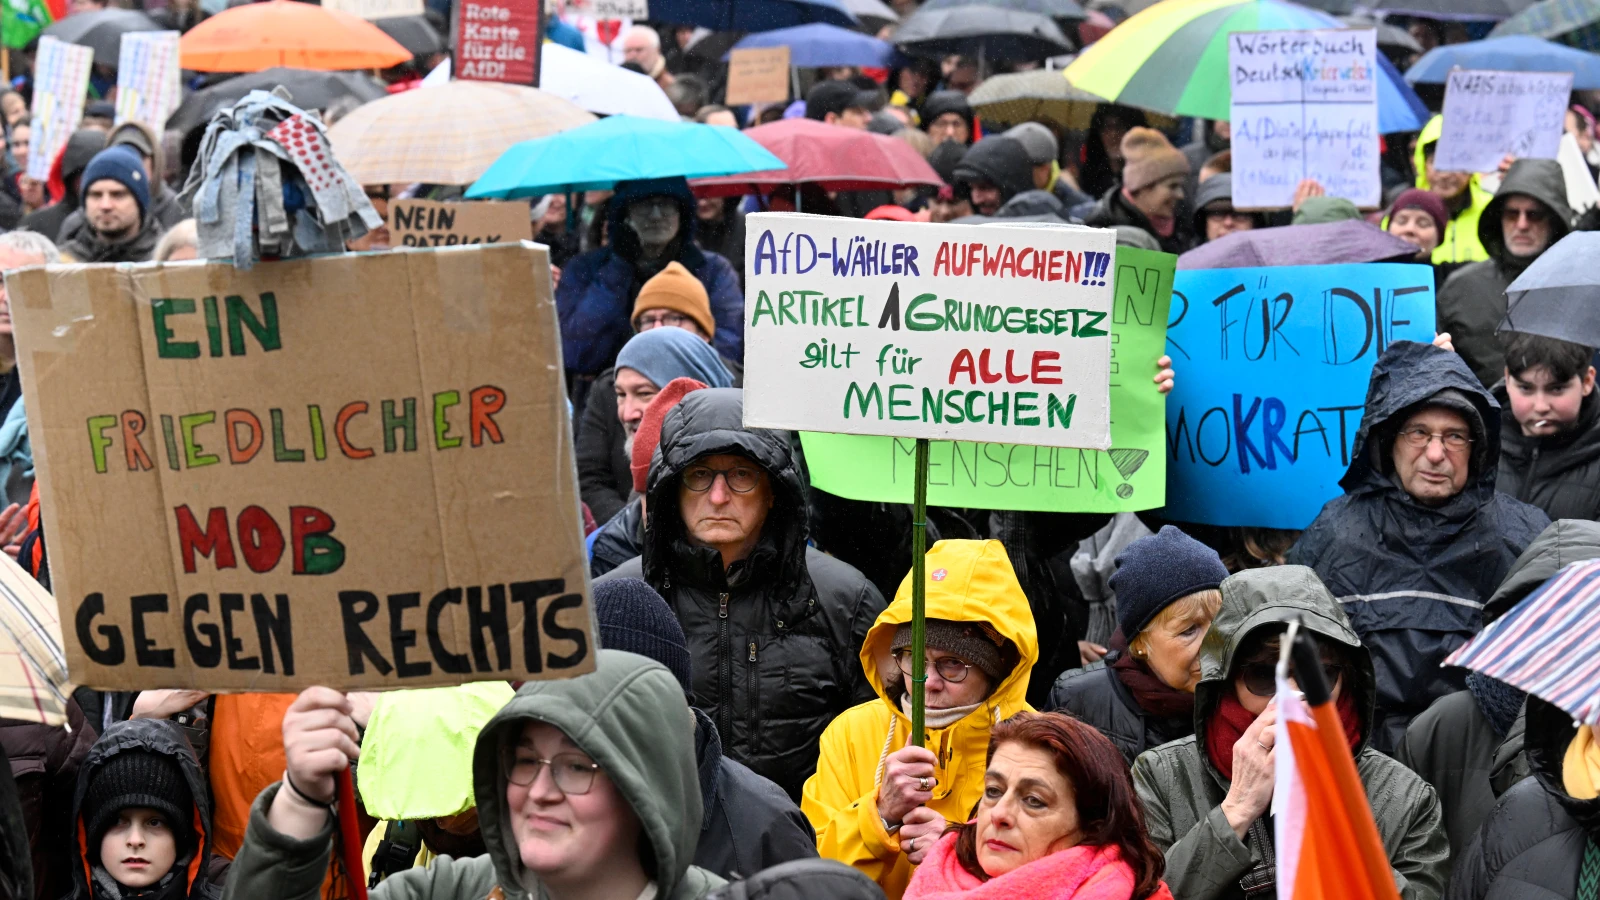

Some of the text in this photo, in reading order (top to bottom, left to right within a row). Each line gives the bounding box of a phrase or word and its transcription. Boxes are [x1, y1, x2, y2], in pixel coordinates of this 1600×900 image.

[464, 22, 520, 41] Karte
[465, 3, 511, 22] Rote
[461, 60, 506, 79] AfD!
[462, 40, 526, 61] für die
[1234, 34, 1366, 57] Wörterbuch
[394, 204, 456, 231] NEIN
[754, 229, 1111, 287] AfD-WÄHLER AUFWACHEN!!!
[150, 291, 282, 359] EIN
[751, 289, 870, 328] ARTIKEL
[904, 292, 1109, 338] GRUNDGESETZ
[1212, 275, 1301, 363] FÜR
[1321, 283, 1430, 366] DIE
[799, 337, 1063, 385] gilt für ALLE
[843, 381, 1078, 429] MENSCHEN
[86, 385, 507, 474] FRIEDLICHER
[173, 503, 346, 576] MOB
[75, 577, 589, 678] GEGEN RECHTS
